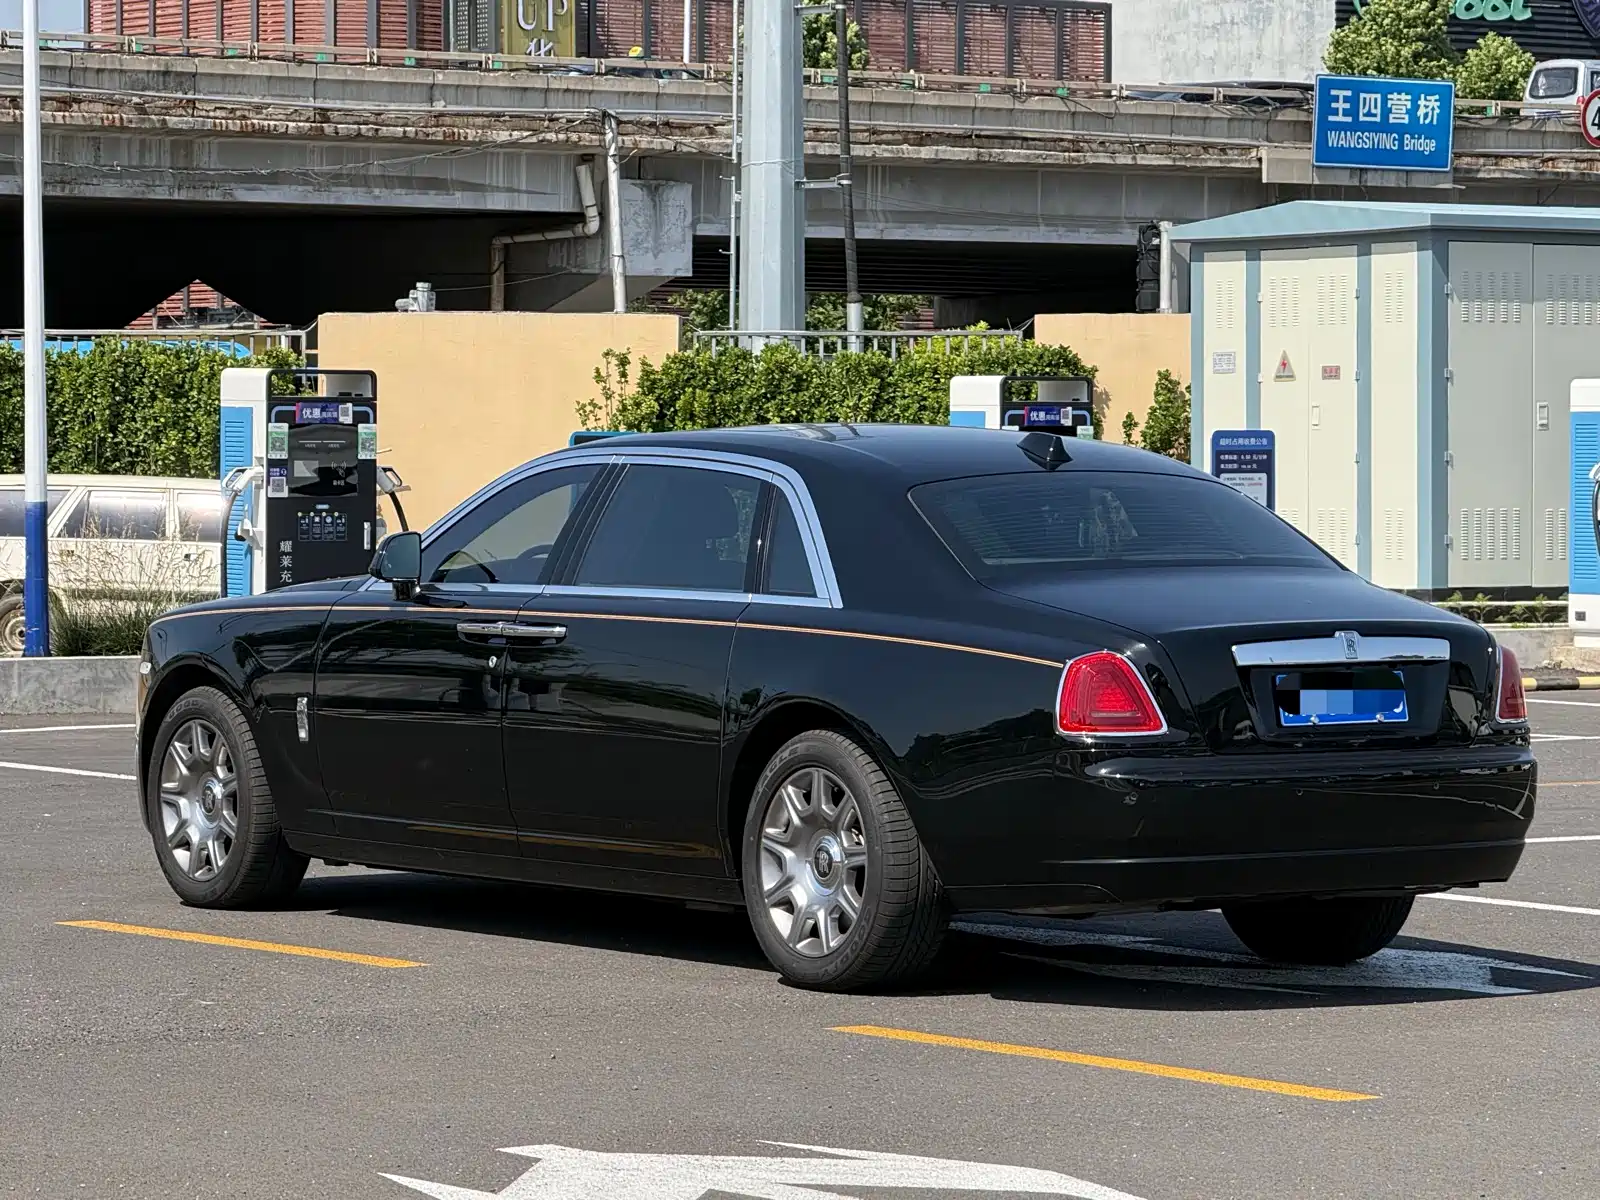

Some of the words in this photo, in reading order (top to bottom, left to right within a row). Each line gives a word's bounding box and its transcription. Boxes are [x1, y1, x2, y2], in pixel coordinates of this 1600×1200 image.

[1327, 89, 1441, 125] 王四营桥
[1327, 130, 1399, 150] WANGSIYING
[1403, 135, 1436, 153] Bridge
[302, 407, 321, 419] 优惠
